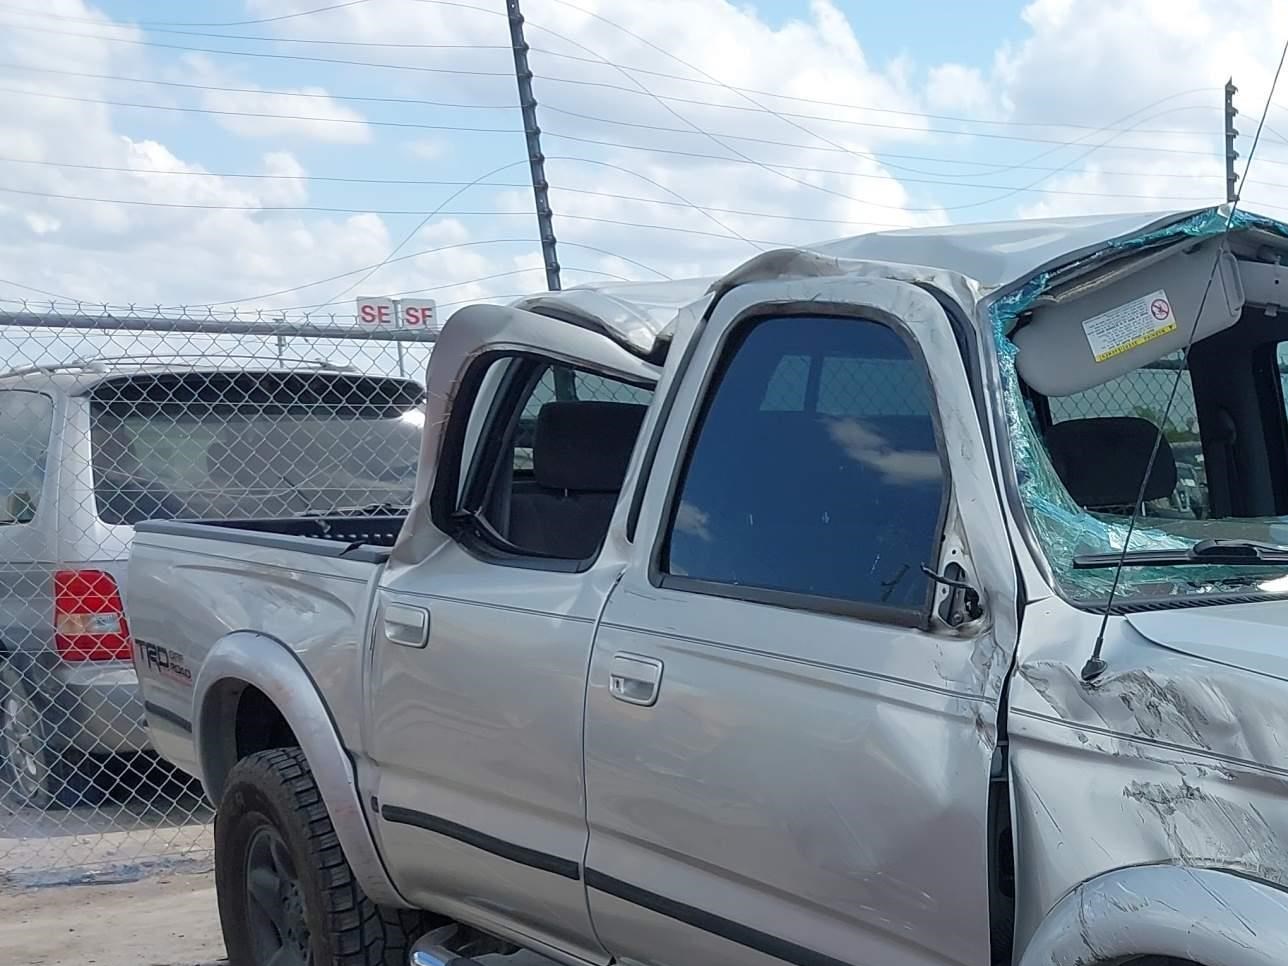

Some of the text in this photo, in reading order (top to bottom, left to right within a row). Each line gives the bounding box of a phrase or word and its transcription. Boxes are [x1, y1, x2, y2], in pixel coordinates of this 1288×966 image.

[361, 305, 391, 324] SE
[405, 307, 433, 325] SF
[134, 638, 169, 673] TRD
